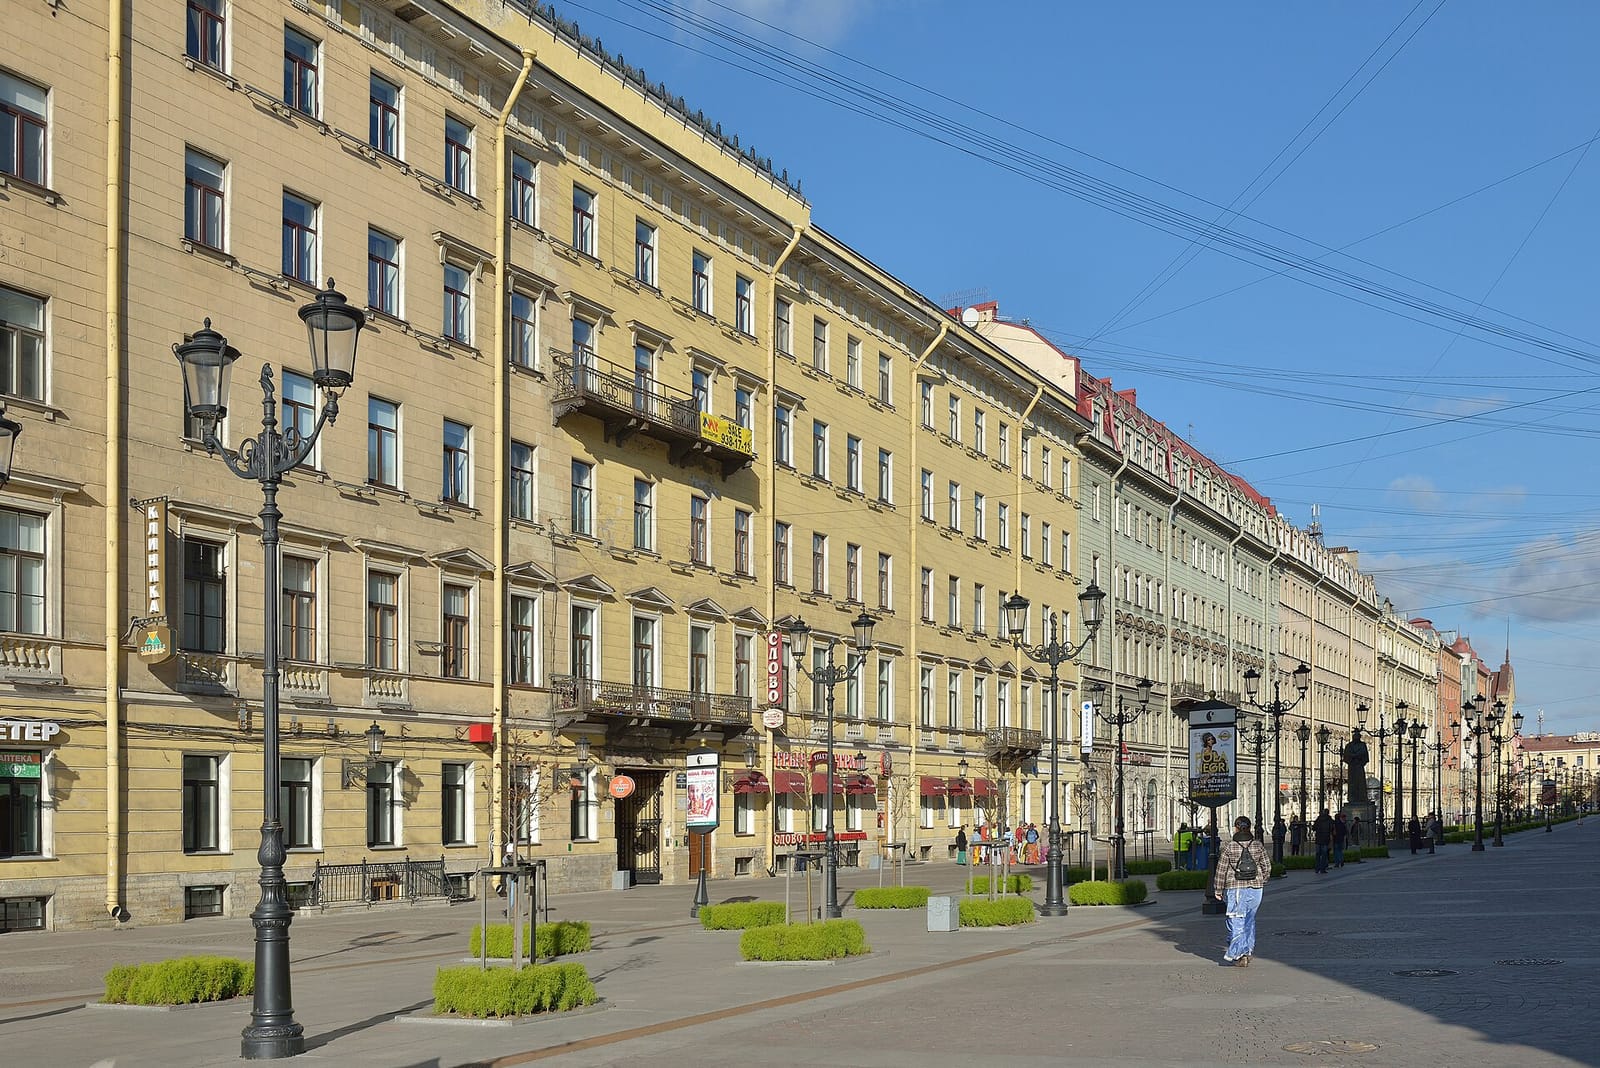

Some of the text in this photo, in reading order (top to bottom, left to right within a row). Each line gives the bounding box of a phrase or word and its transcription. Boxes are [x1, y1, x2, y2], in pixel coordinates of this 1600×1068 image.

[148, 506, 160, 613] КЛИНИКА
[768, 632, 779, 702] СЛОВО
[1195, 751, 1228, 762] POLA
[774, 834, 802, 845] СЛОВО
